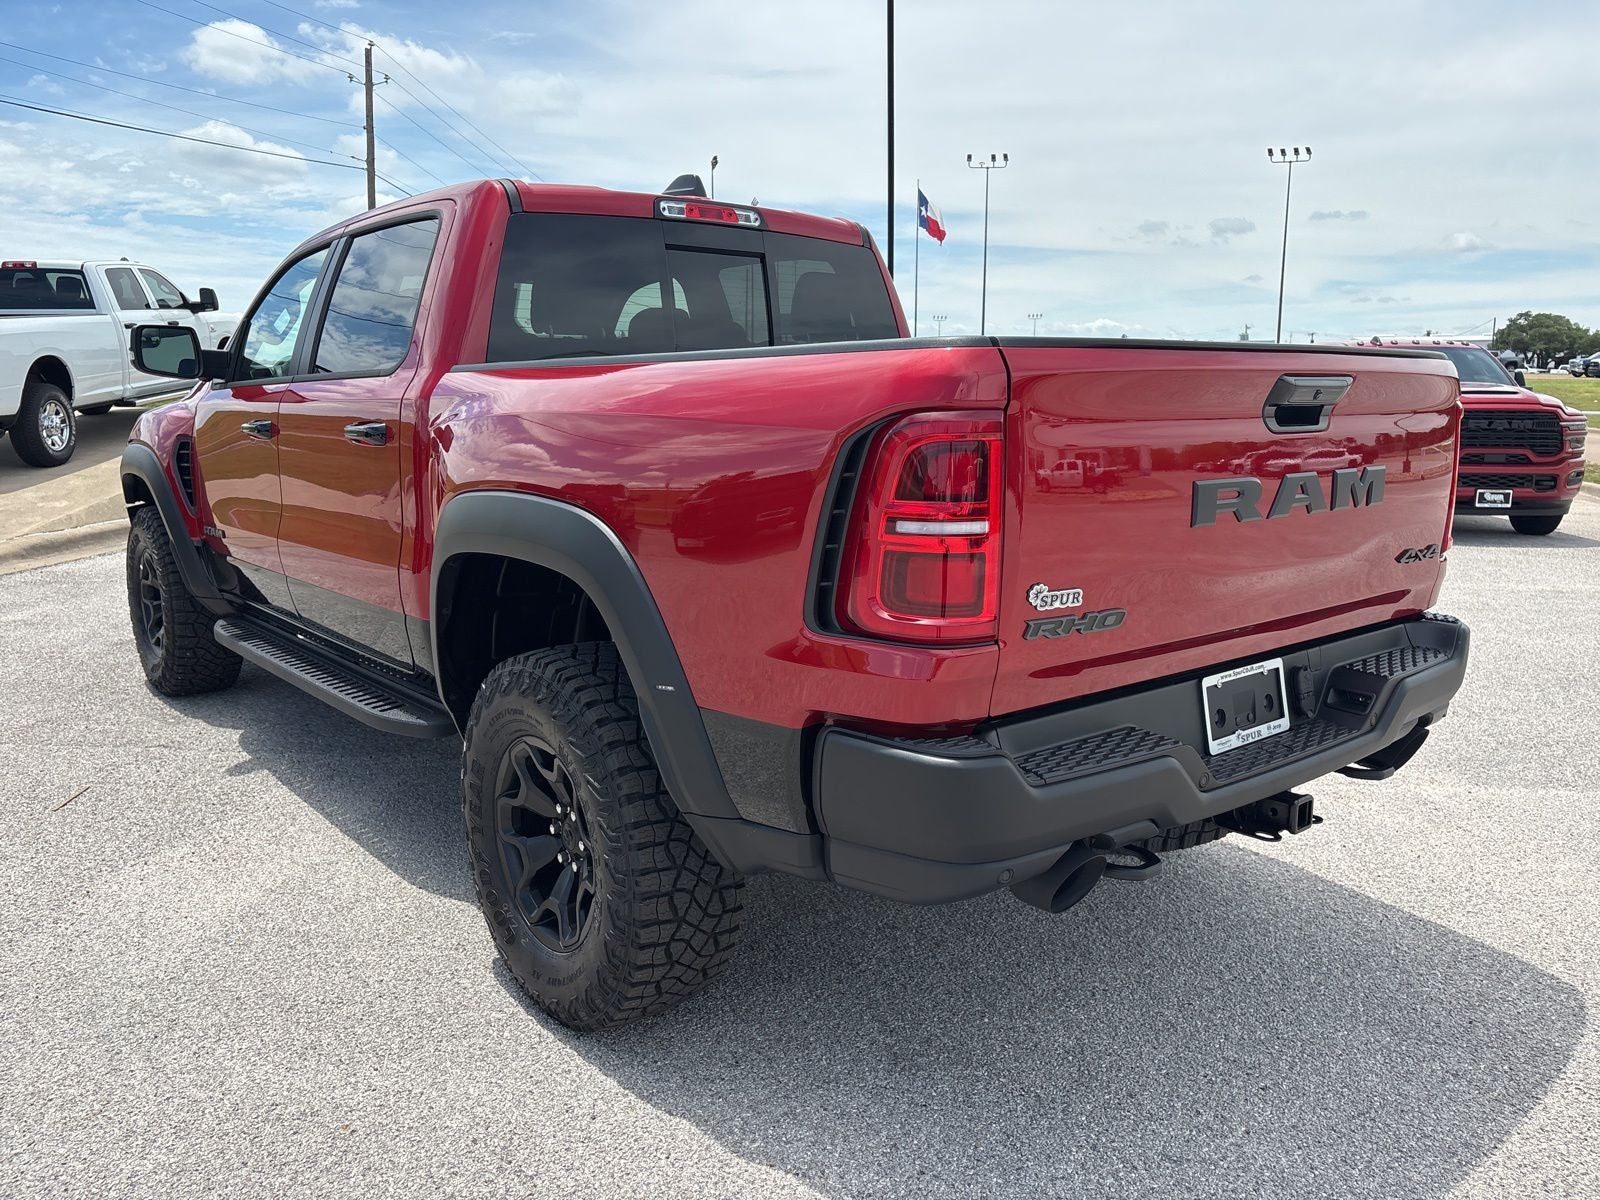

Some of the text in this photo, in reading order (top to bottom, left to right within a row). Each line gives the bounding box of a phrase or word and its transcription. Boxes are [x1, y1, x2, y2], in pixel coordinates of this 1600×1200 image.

[1190, 465, 1386, 528] RAM
[204, 526, 225, 538] RAM
[1039, 591, 1081, 608] SPUR
[1023, 608, 1127, 640] RHO
[1241, 730, 1262, 743] SPUR
